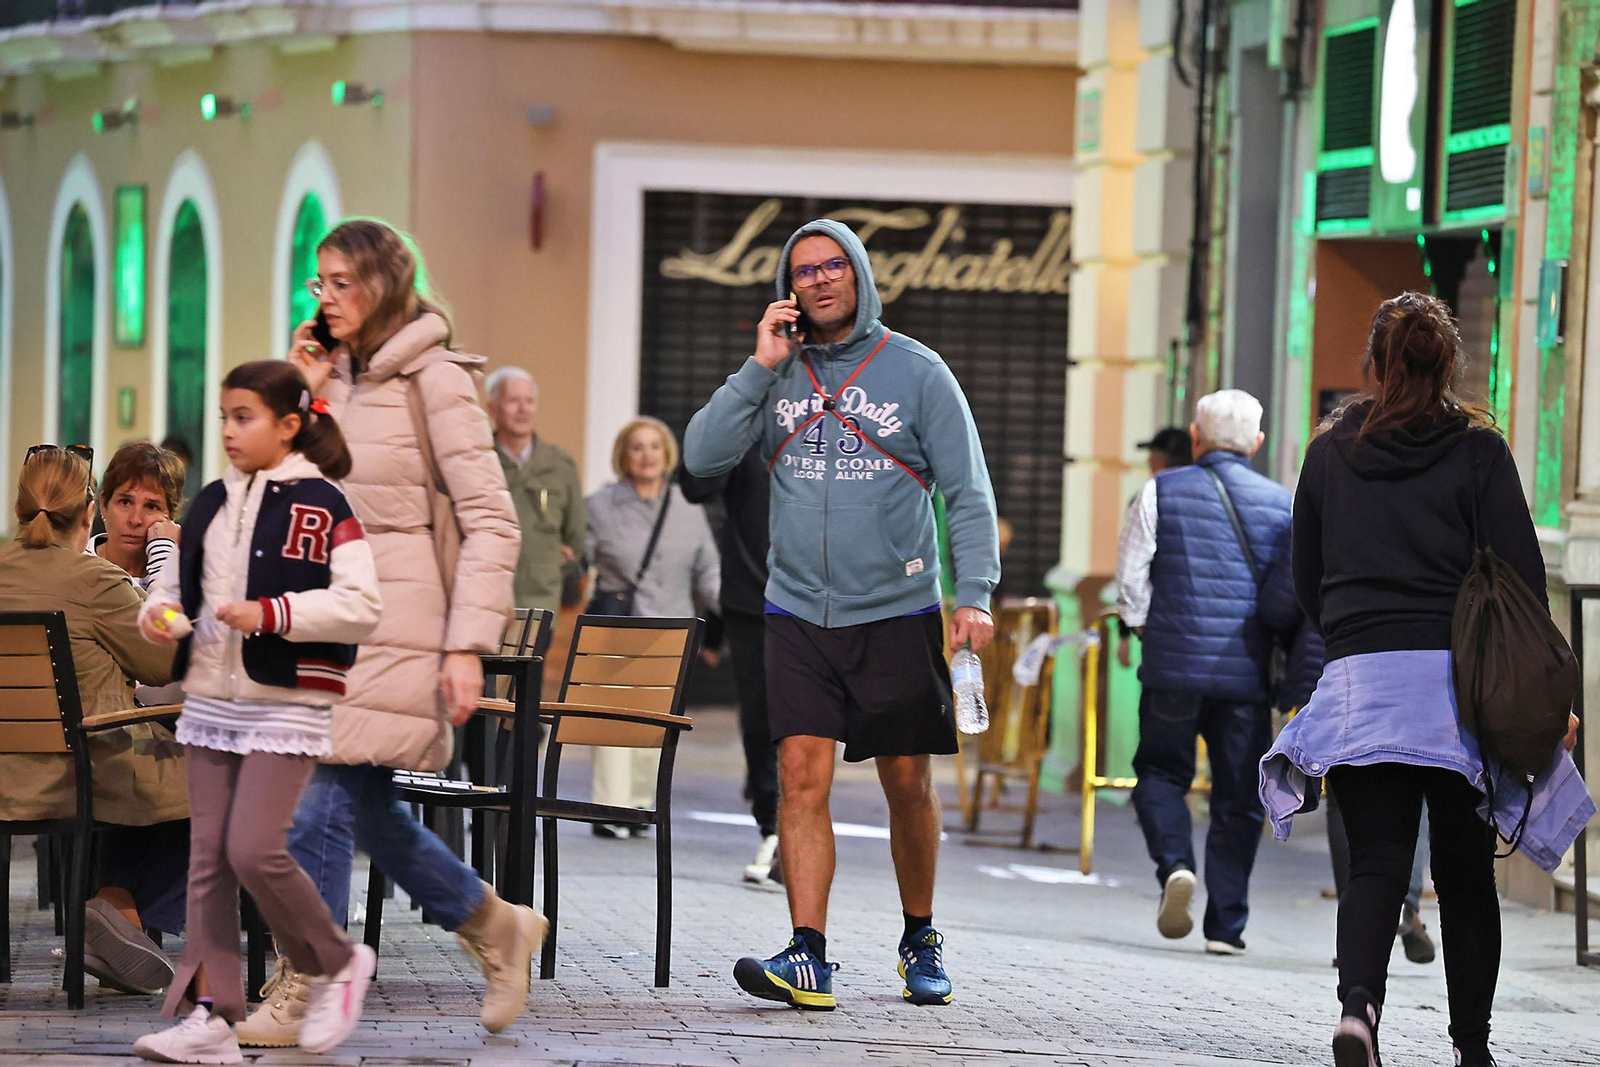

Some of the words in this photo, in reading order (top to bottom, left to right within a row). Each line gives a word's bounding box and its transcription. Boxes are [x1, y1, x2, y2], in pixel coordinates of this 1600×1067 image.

[659, 198, 783, 286] La
[840, 386, 903, 437] Daily
[782, 454, 827, 471] OVER
[835, 458, 895, 471] COME
[793, 469, 825, 480] LOOK
[835, 471, 874, 480] ALIVE
[281, 503, 333, 565] R
